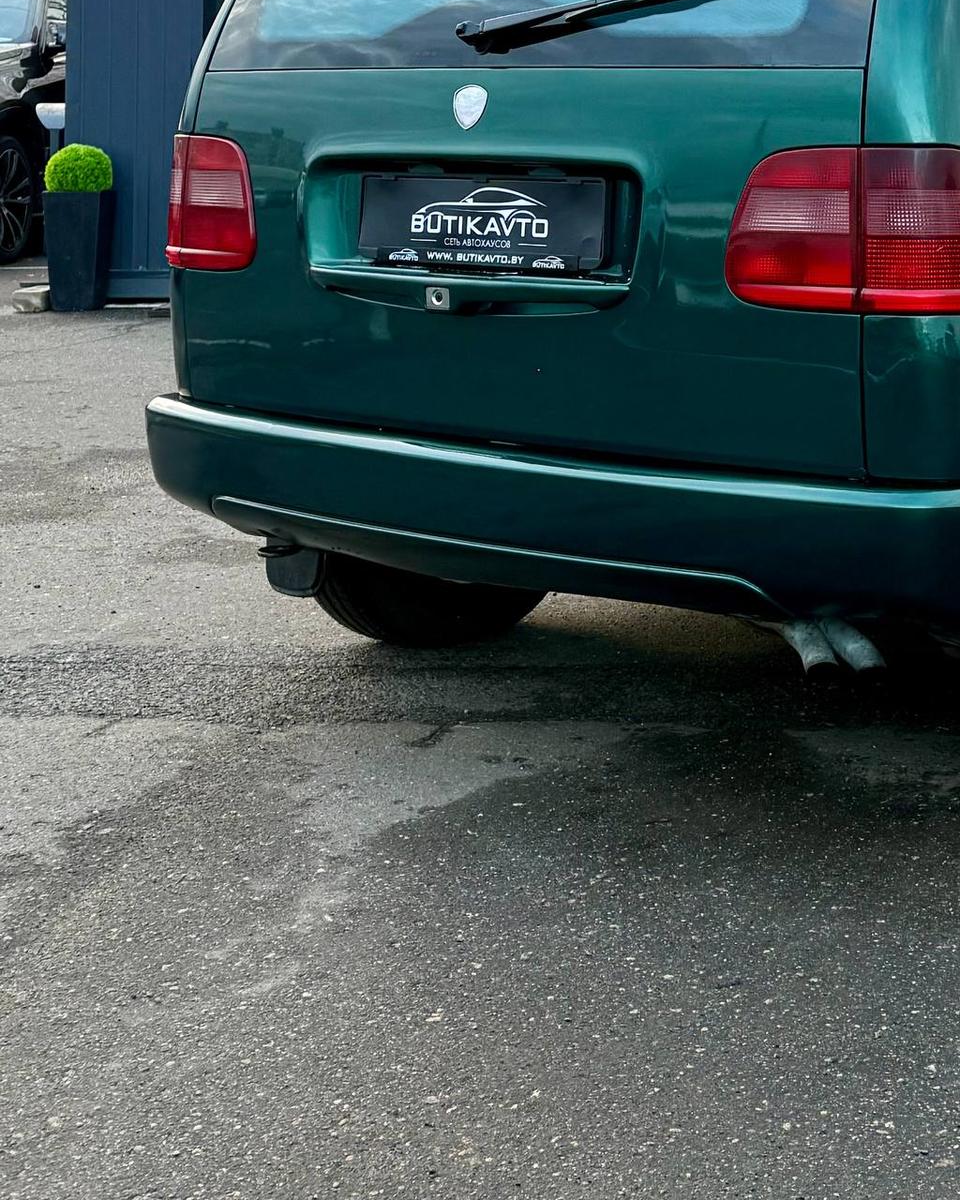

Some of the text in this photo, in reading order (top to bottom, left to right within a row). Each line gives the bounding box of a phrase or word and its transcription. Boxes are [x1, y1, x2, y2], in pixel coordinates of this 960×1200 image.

[410, 214, 549, 238] BUTIKAVTO
[444, 237, 511, 249] СЕТЬ АВТОХАУСОВ
[456, 253, 524, 265] BUTIKAVTO.BY
